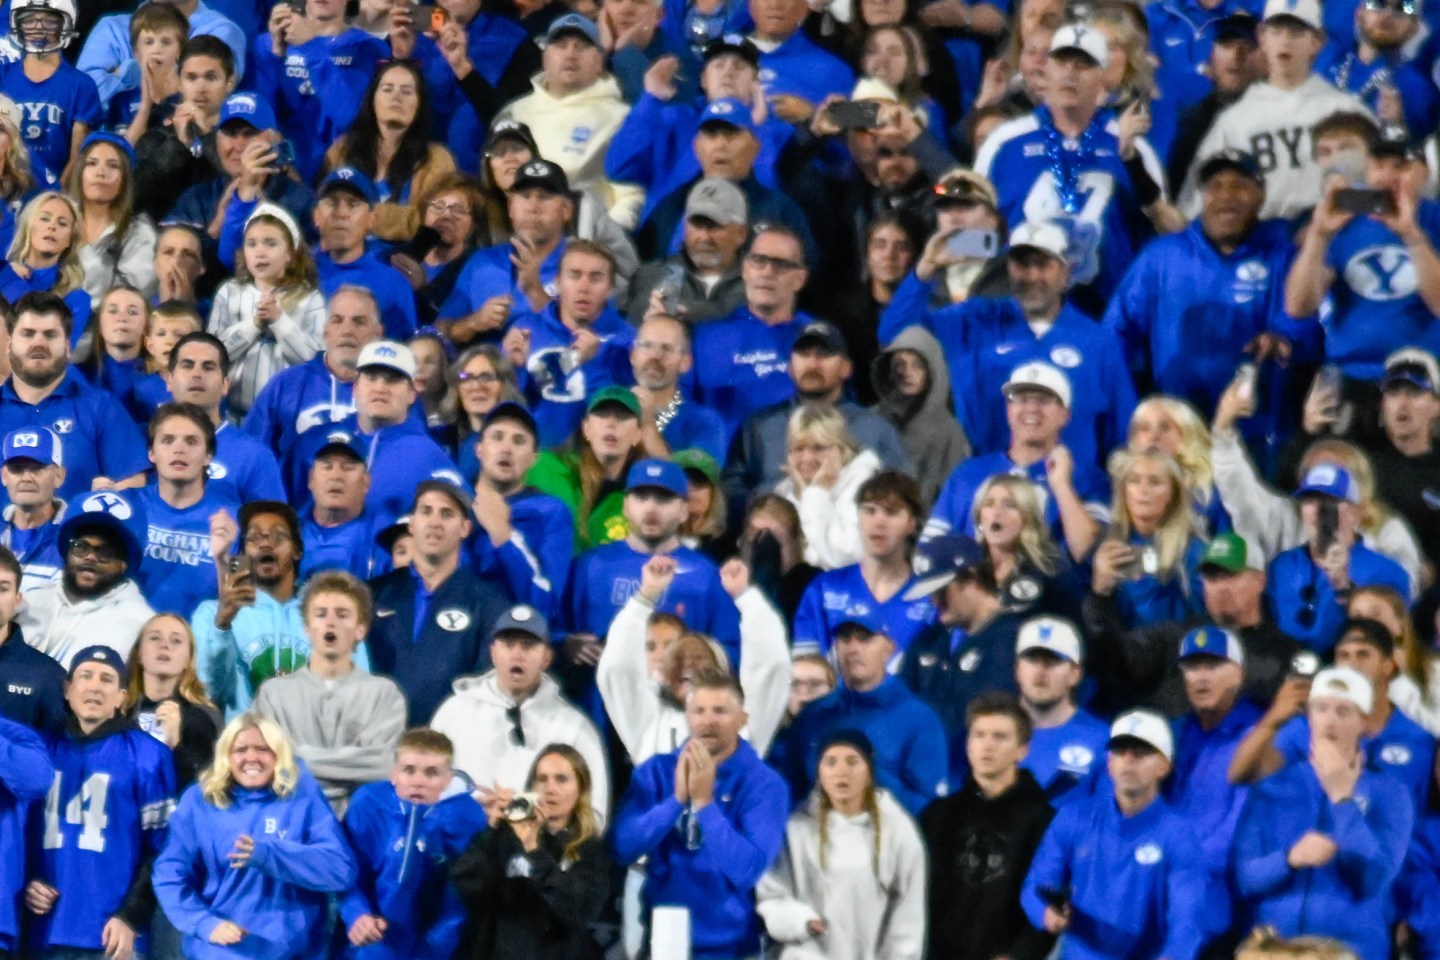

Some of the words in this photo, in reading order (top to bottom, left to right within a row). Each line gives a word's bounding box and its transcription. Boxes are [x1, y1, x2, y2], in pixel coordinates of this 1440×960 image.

[1250, 126, 1316, 173] BY
[1361, 250, 1411, 296] Y
[148, 530, 212, 556] RIGHAM
[441, 611, 466, 630] Y
[7, 684, 33, 696] BYU
[44, 771, 111, 853] 14
